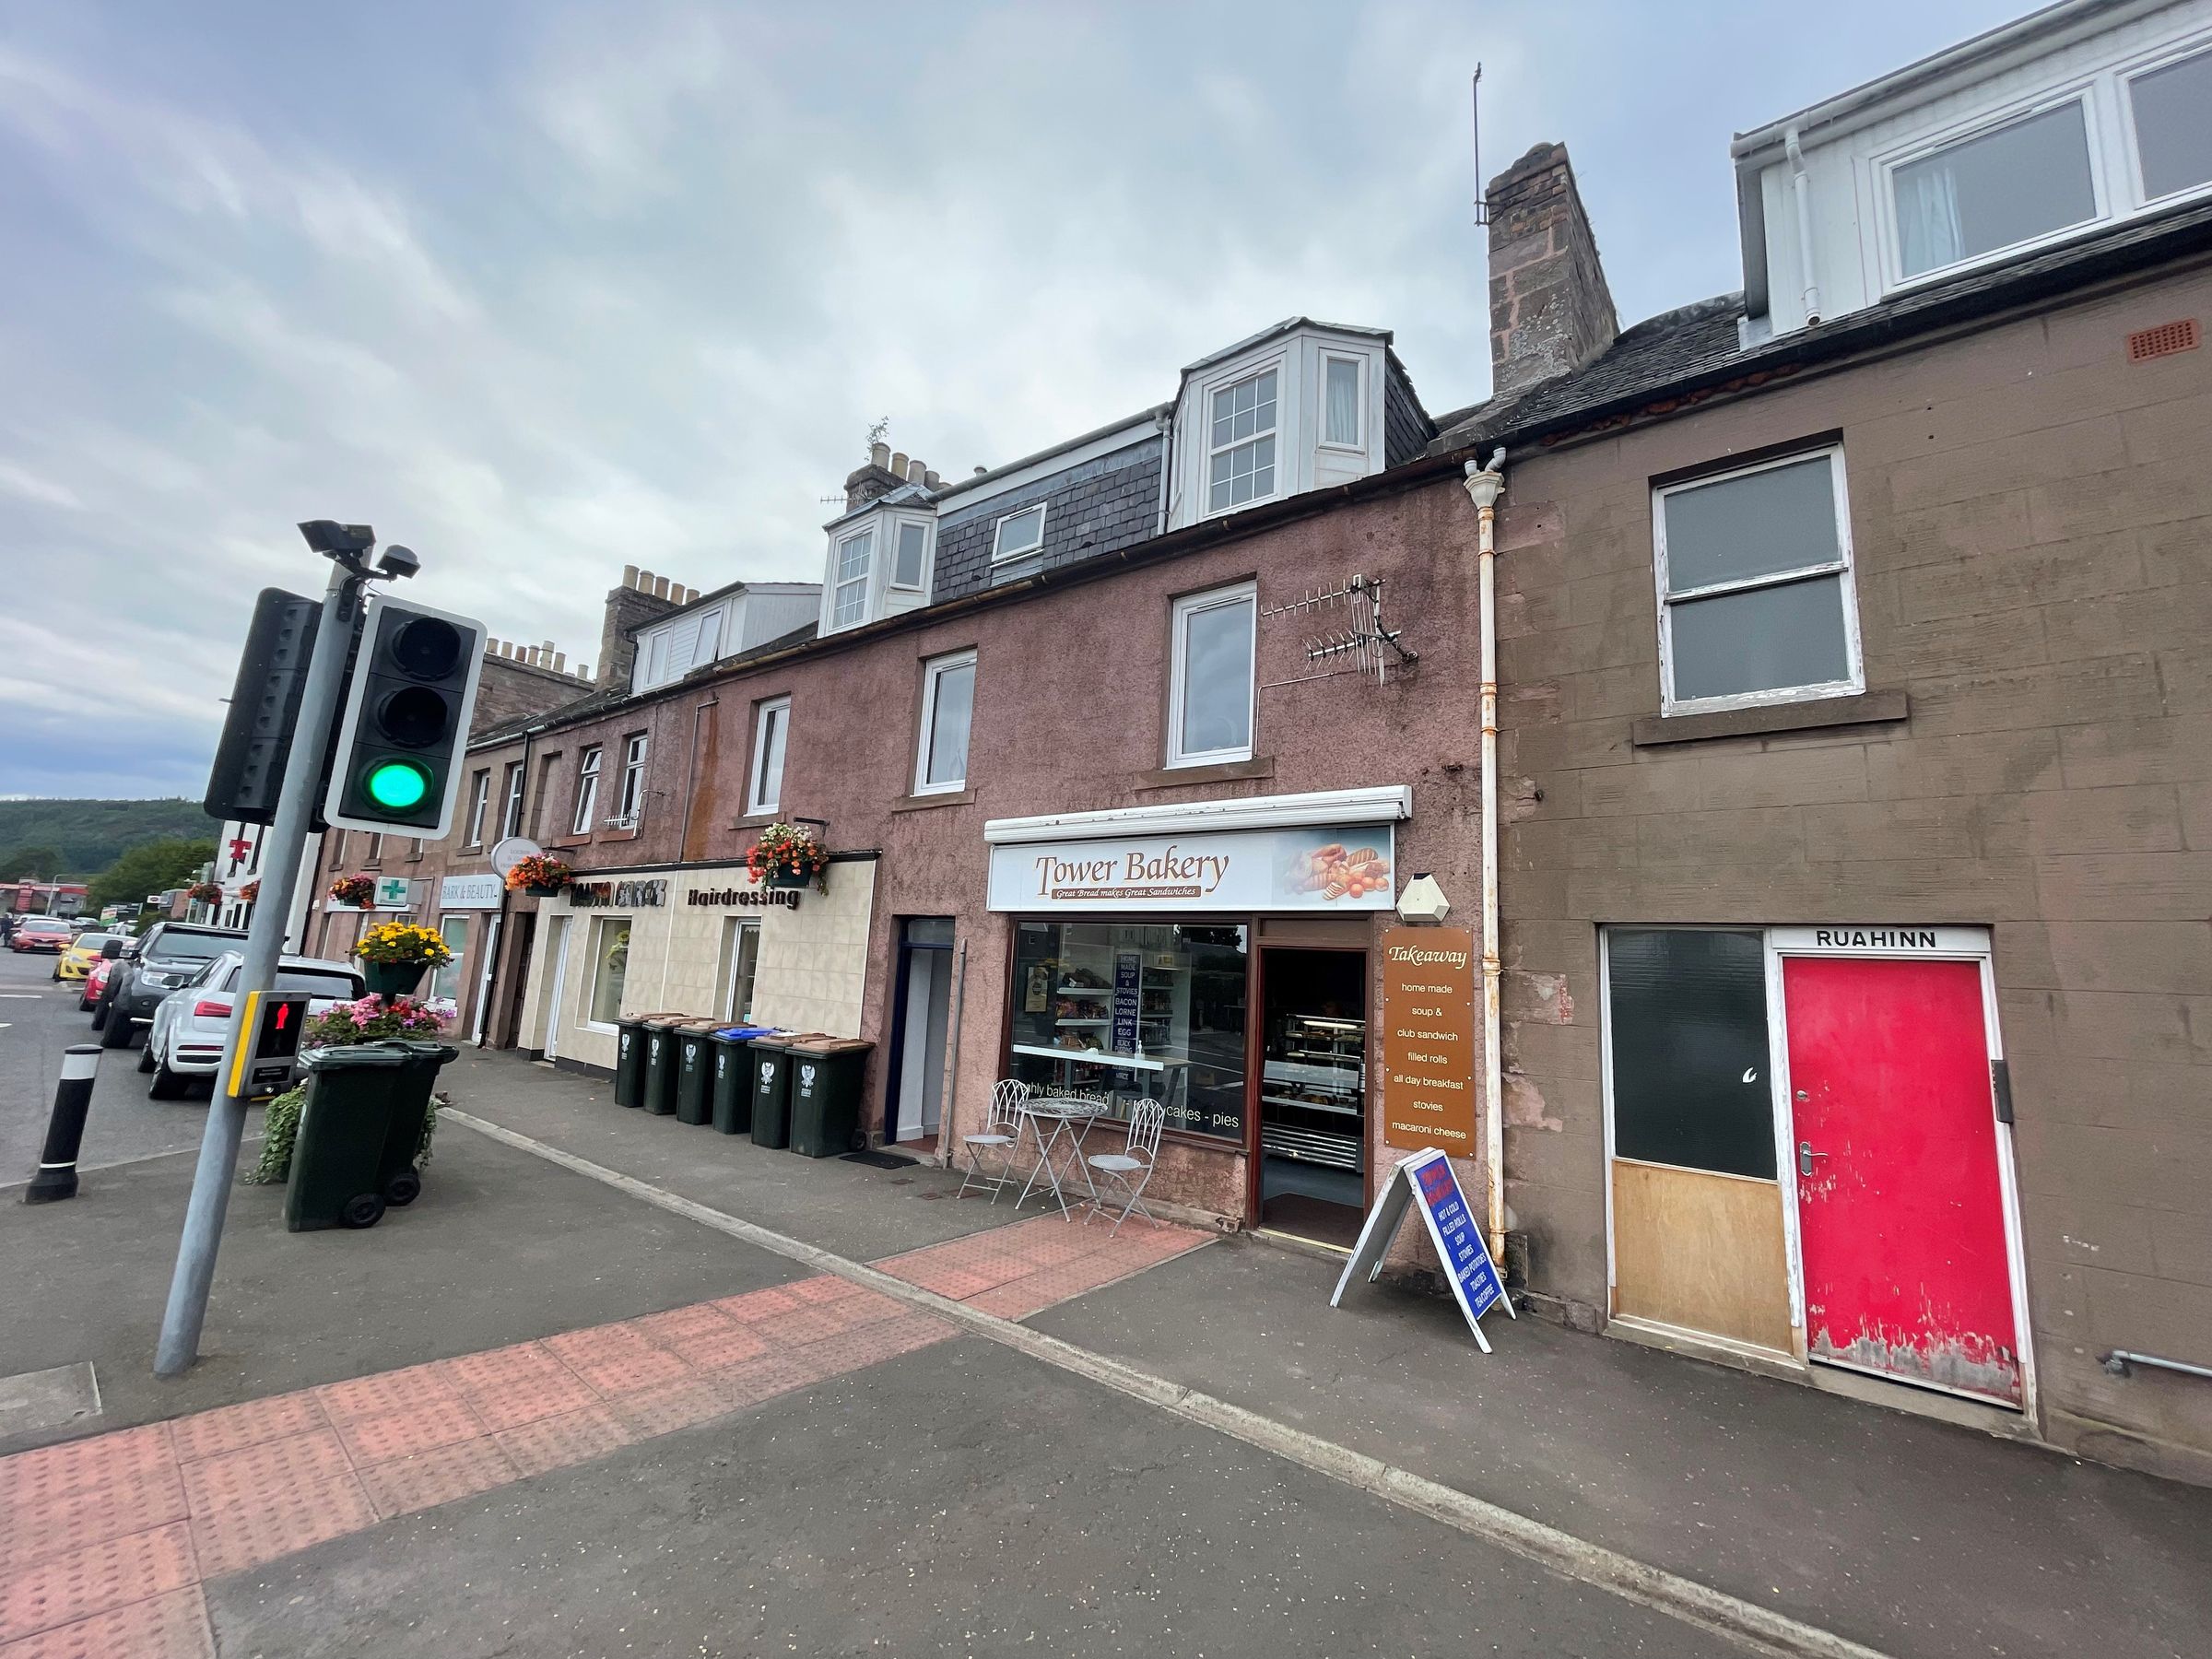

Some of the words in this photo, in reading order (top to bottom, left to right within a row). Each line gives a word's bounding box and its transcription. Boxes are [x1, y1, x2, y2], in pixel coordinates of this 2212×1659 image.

[1036, 856, 1118, 895] Tower
[1124, 845, 1230, 893] Bakery
[688, 888, 800, 911] Hairdressing
[1056, 889, 1076, 900] Great
[1077, 888, 1099, 898] Bread
[1100, 888, 1124, 899] makes
[1124, 888, 1147, 899] Great
[1147, 886, 1196, 897] Sandwiches
[1816, 930, 1936, 948] RUAHINN
[1388, 945, 1467, 970] Takeaway
[1116, 987, 1138, 995] STOVIES
[1401, 982, 1426, 993] home
[1427, 984, 1453, 994] made
[1114, 997, 1137, 1006] BACON
[1114, 1007, 1136, 1017] LORNE
[1411, 1007, 1433, 1018] soup
[1435, 1007, 1442, 1017] &
[1117, 1018, 1133, 1026] LINK
[1117, 1028, 1132, 1036] EGG
[1397, 1029, 1416, 1038] club
[1417, 1031, 1459, 1041] sandwich
[1407, 1052, 1428, 1063] filled
[1430, 1054, 1448, 1065] rolls
[1393, 1074, 1404, 1083] all
[1405, 1075, 1421, 1087] day
[1422, 1077, 1464, 1090] breakfast
[1046, 1084, 1077, 1100] baked
[1079, 1089, 1110, 1105] bread
[1413, 1100, 1443, 1112] stovies
[1166, 1105, 1201, 1122] cakes
[1212, 1112, 1240, 1128] pies
[1392, 1122, 1432, 1135] macaroni
[1433, 1126, 1466, 1140] cheese
[1442, 1220, 1456, 1236] FILLED
